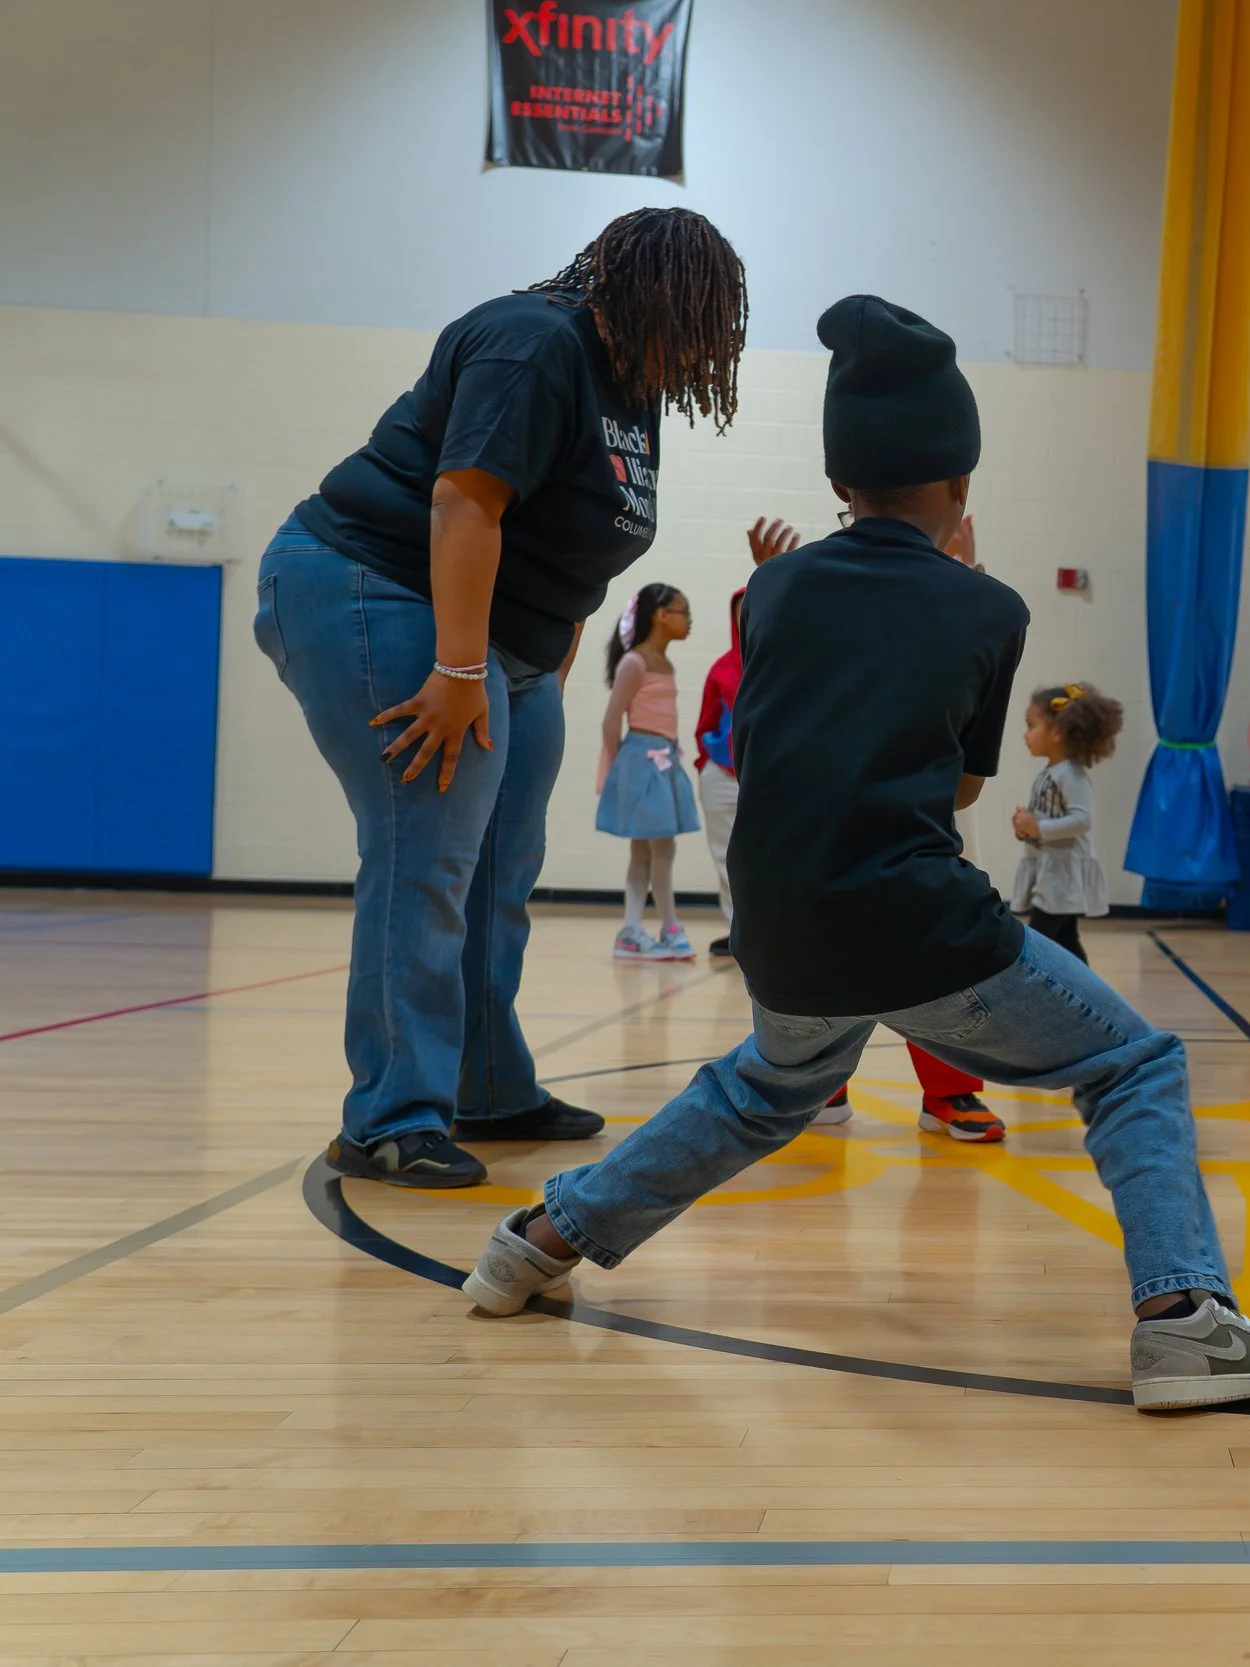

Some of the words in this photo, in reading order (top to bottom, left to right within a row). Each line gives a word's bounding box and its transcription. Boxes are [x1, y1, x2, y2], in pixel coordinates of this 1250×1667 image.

[502, 1, 674, 65] xfinity
[529, 85, 621, 105] INTERNET
[510, 102, 622, 123] ESSENTIALS
[601, 416, 648, 455] Black
